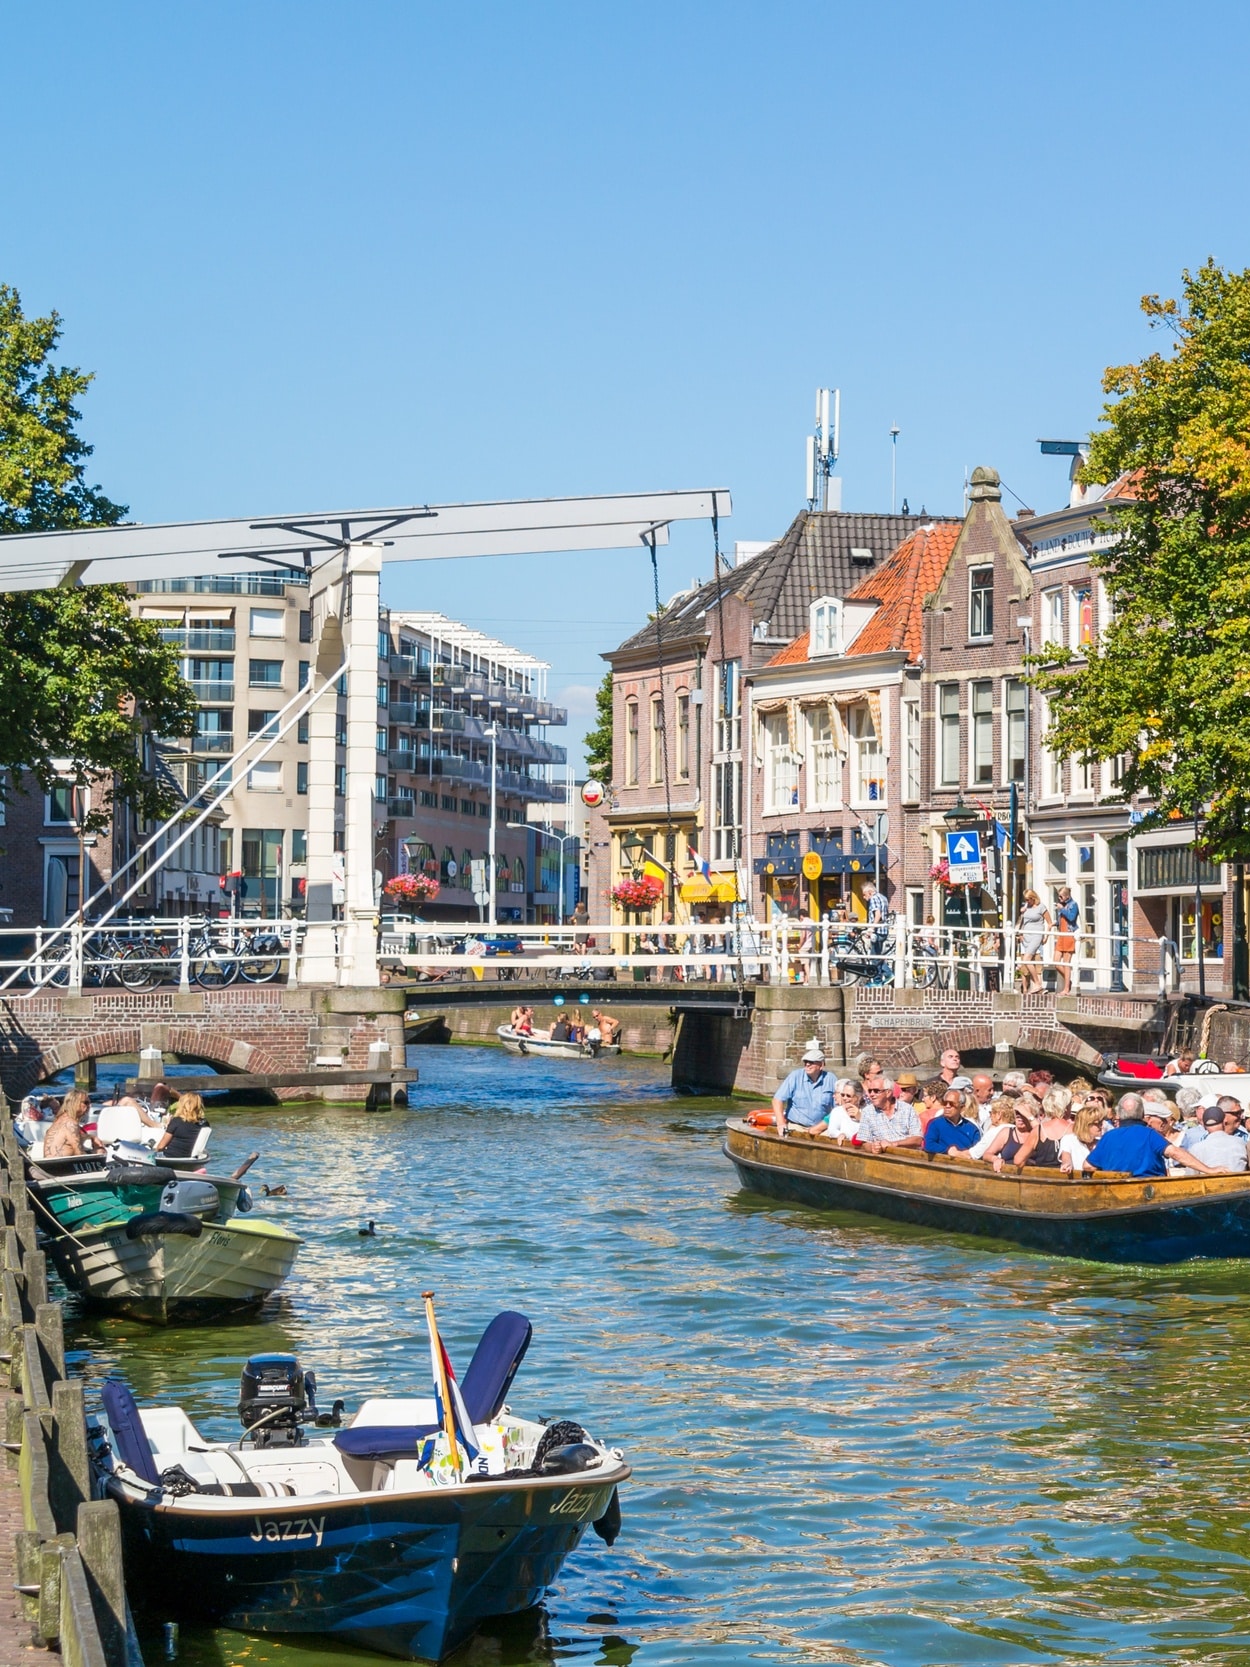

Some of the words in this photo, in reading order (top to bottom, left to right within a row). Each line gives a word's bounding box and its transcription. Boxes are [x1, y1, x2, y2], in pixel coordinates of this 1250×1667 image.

[1040, 537, 1060, 556] LAND
[1068, 530, 1091, 550] BOUW
[514, 909, 520, 919] P
[875, 1017, 931, 1026] SCHAPENBRUG
[209, 1231, 231, 1248] Floris
[549, 1487, 599, 1522] Jazzy
[250, 1516, 326, 1547] Jazzy
